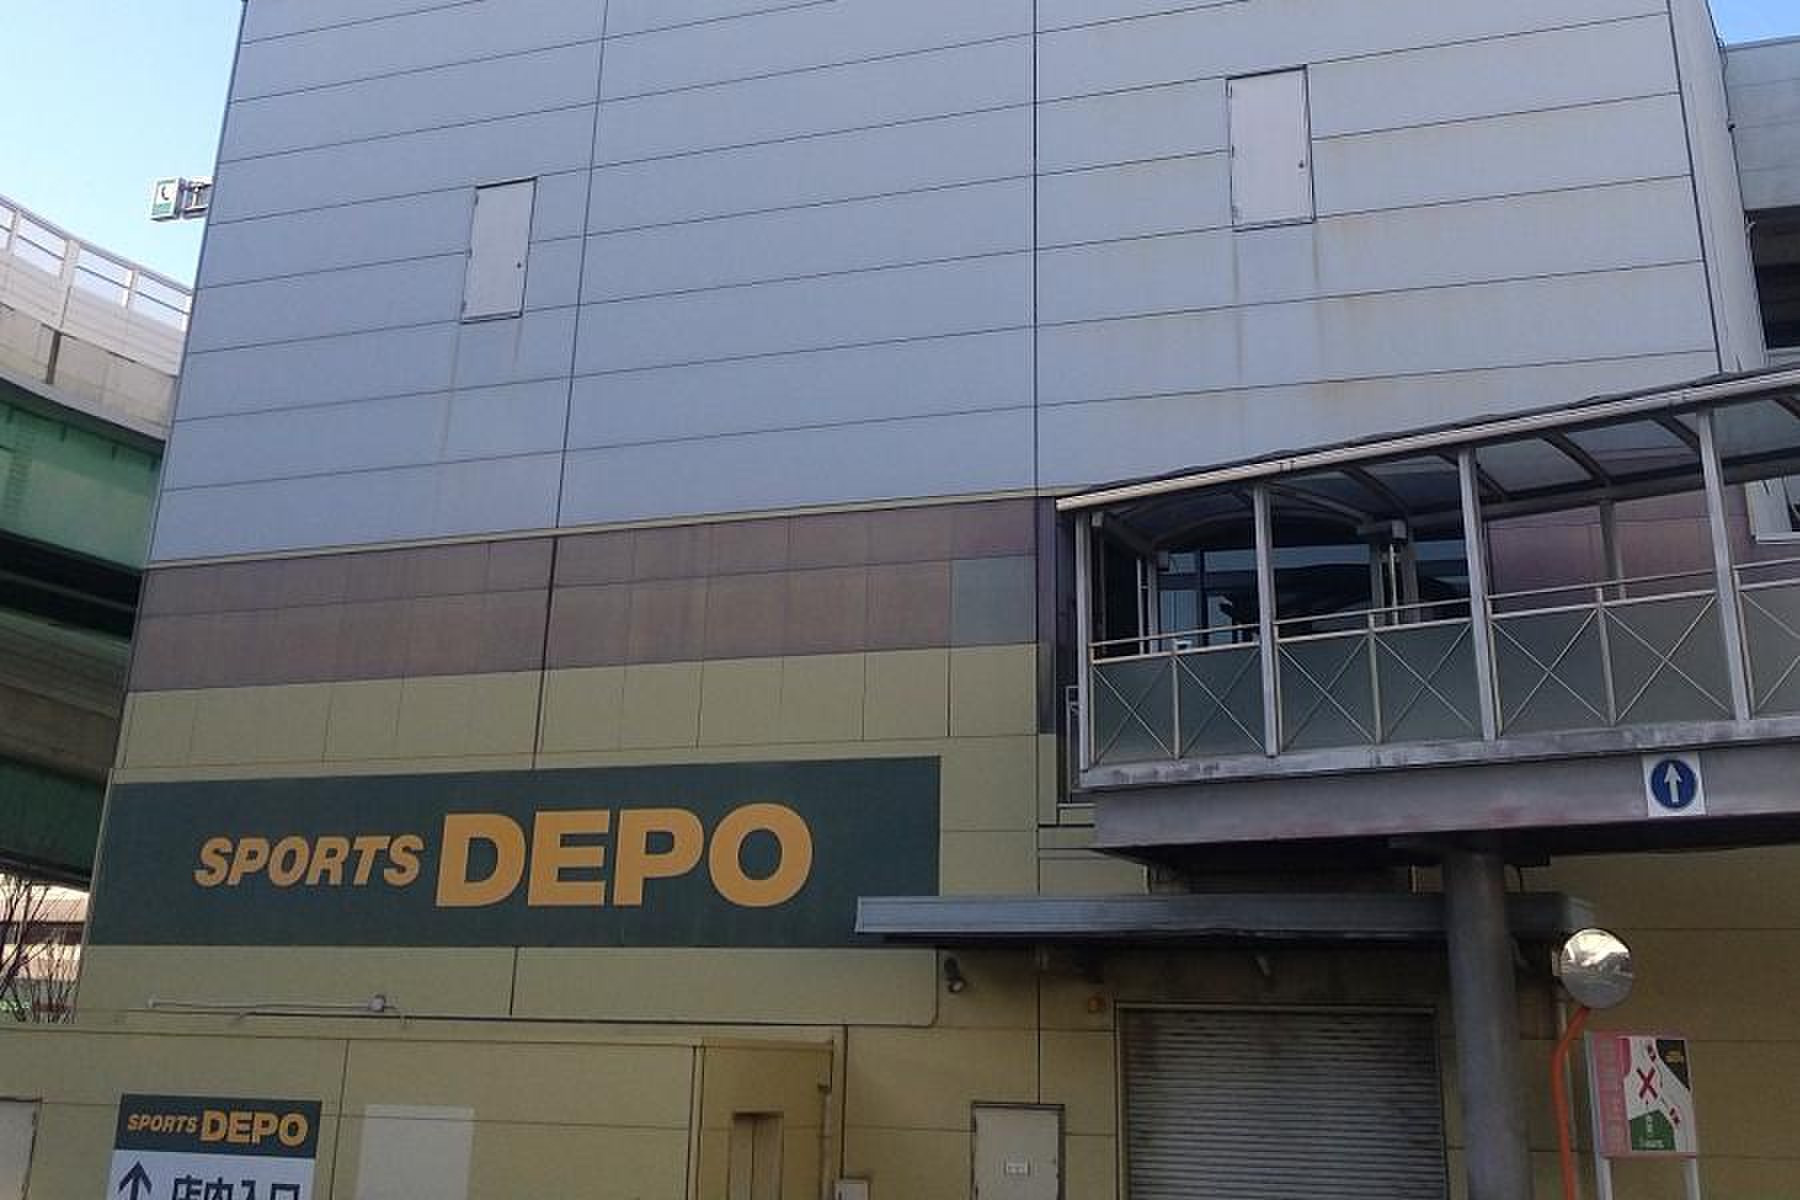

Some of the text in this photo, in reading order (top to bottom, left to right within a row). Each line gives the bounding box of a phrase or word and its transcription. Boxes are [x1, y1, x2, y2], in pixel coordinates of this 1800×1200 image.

[193, 803, 813, 907] SPORTS DEPO
[127, 1109, 308, 1148] SPORTS DEPO
